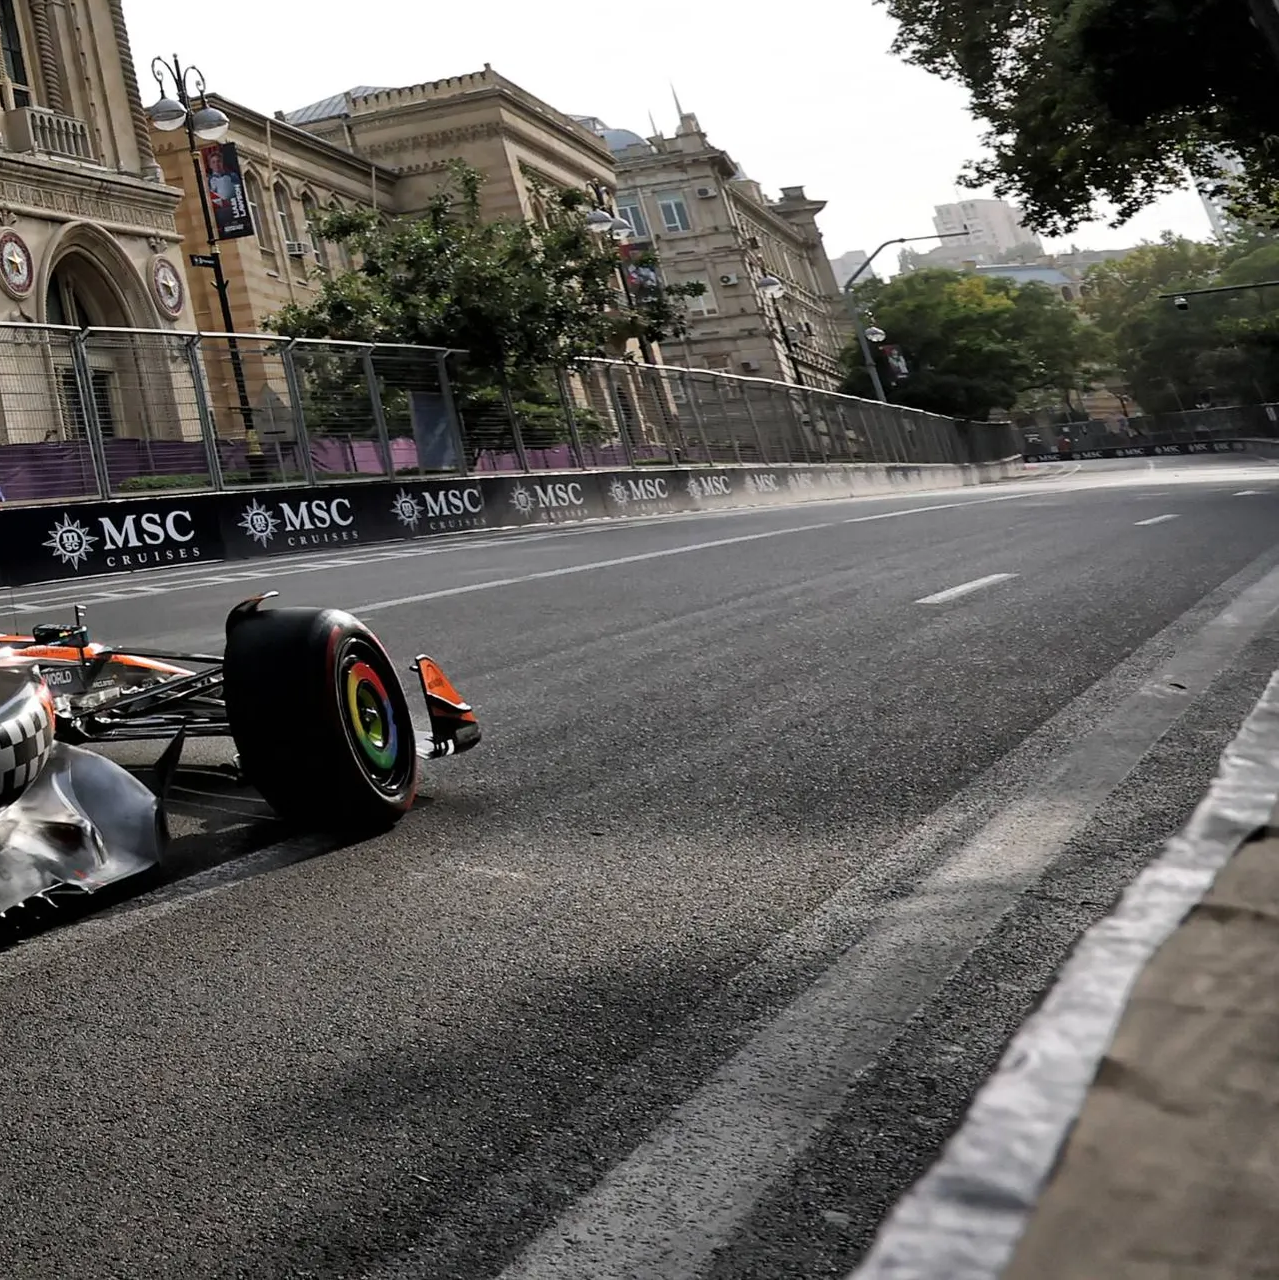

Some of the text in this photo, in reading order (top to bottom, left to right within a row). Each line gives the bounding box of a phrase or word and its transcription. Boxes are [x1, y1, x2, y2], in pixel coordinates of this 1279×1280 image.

[533, 482, 584, 508] MSC
[627, 478, 669, 500] MSC
[278, 498, 354, 532] MSC
[421, 488, 482, 517] MSC
[97, 510, 195, 550] MSC
[288, 530, 360, 547] CRUISES
[106, 546, 201, 568] CRUISES
